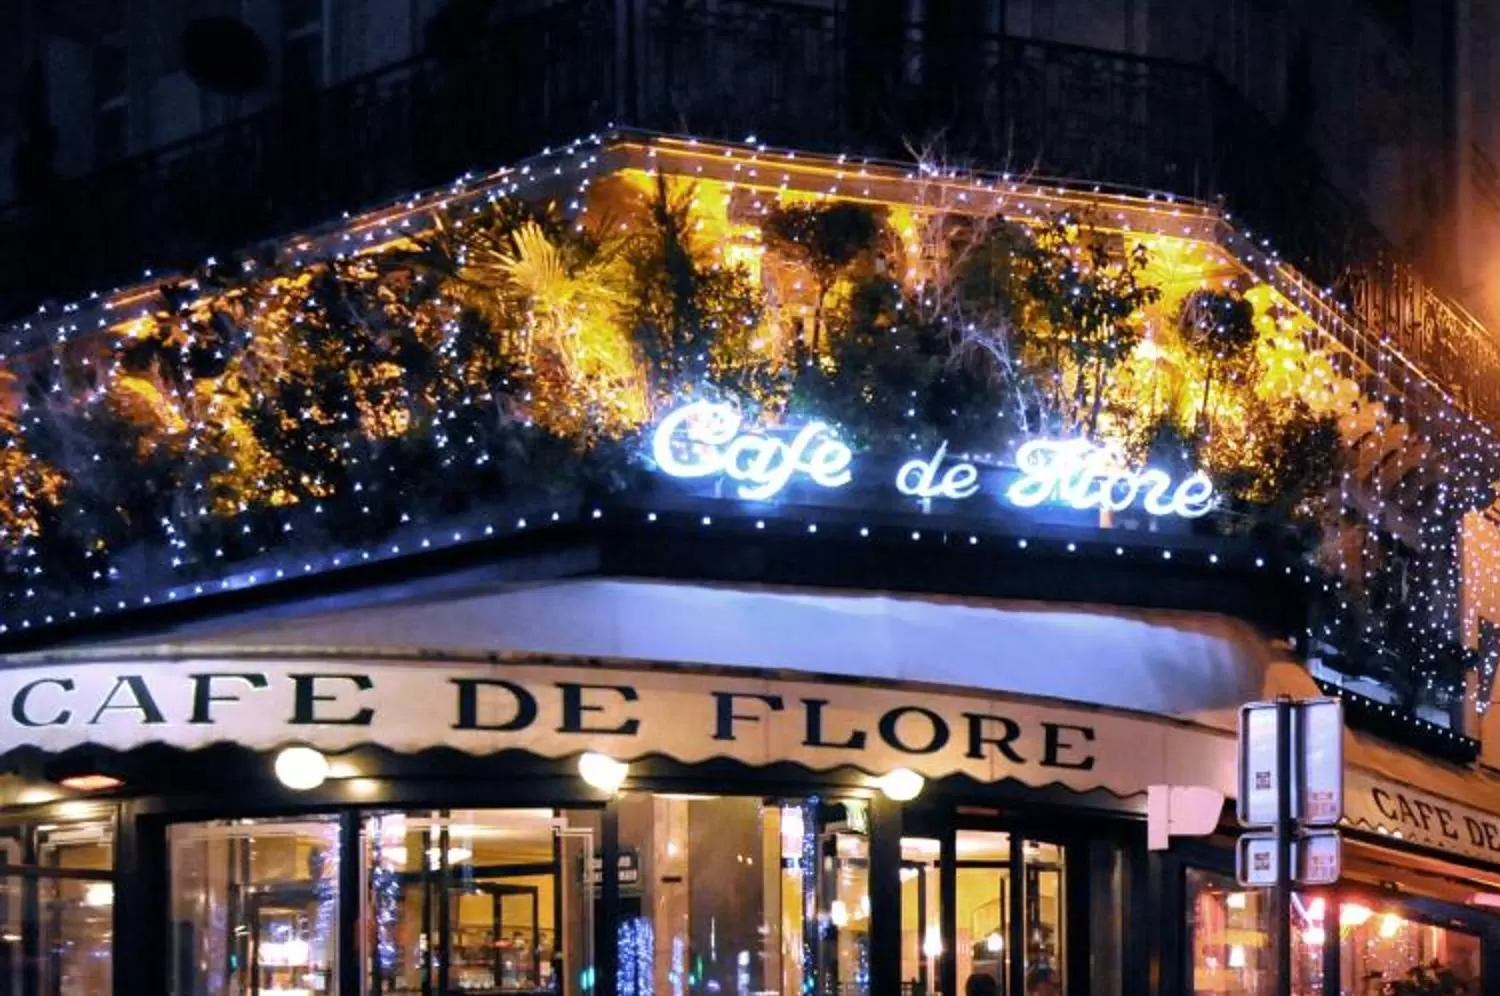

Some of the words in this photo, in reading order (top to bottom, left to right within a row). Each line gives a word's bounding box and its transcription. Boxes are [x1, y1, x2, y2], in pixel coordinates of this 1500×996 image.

[896, 440, 979, 499] de
[1005, 437, 1213, 518] Flore
[11, 673, 374, 727] CAFE
[449, 677, 641, 735] DE
[711, 691, 1096, 770] FLORE
[1371, 787, 1459, 840] CAFE
